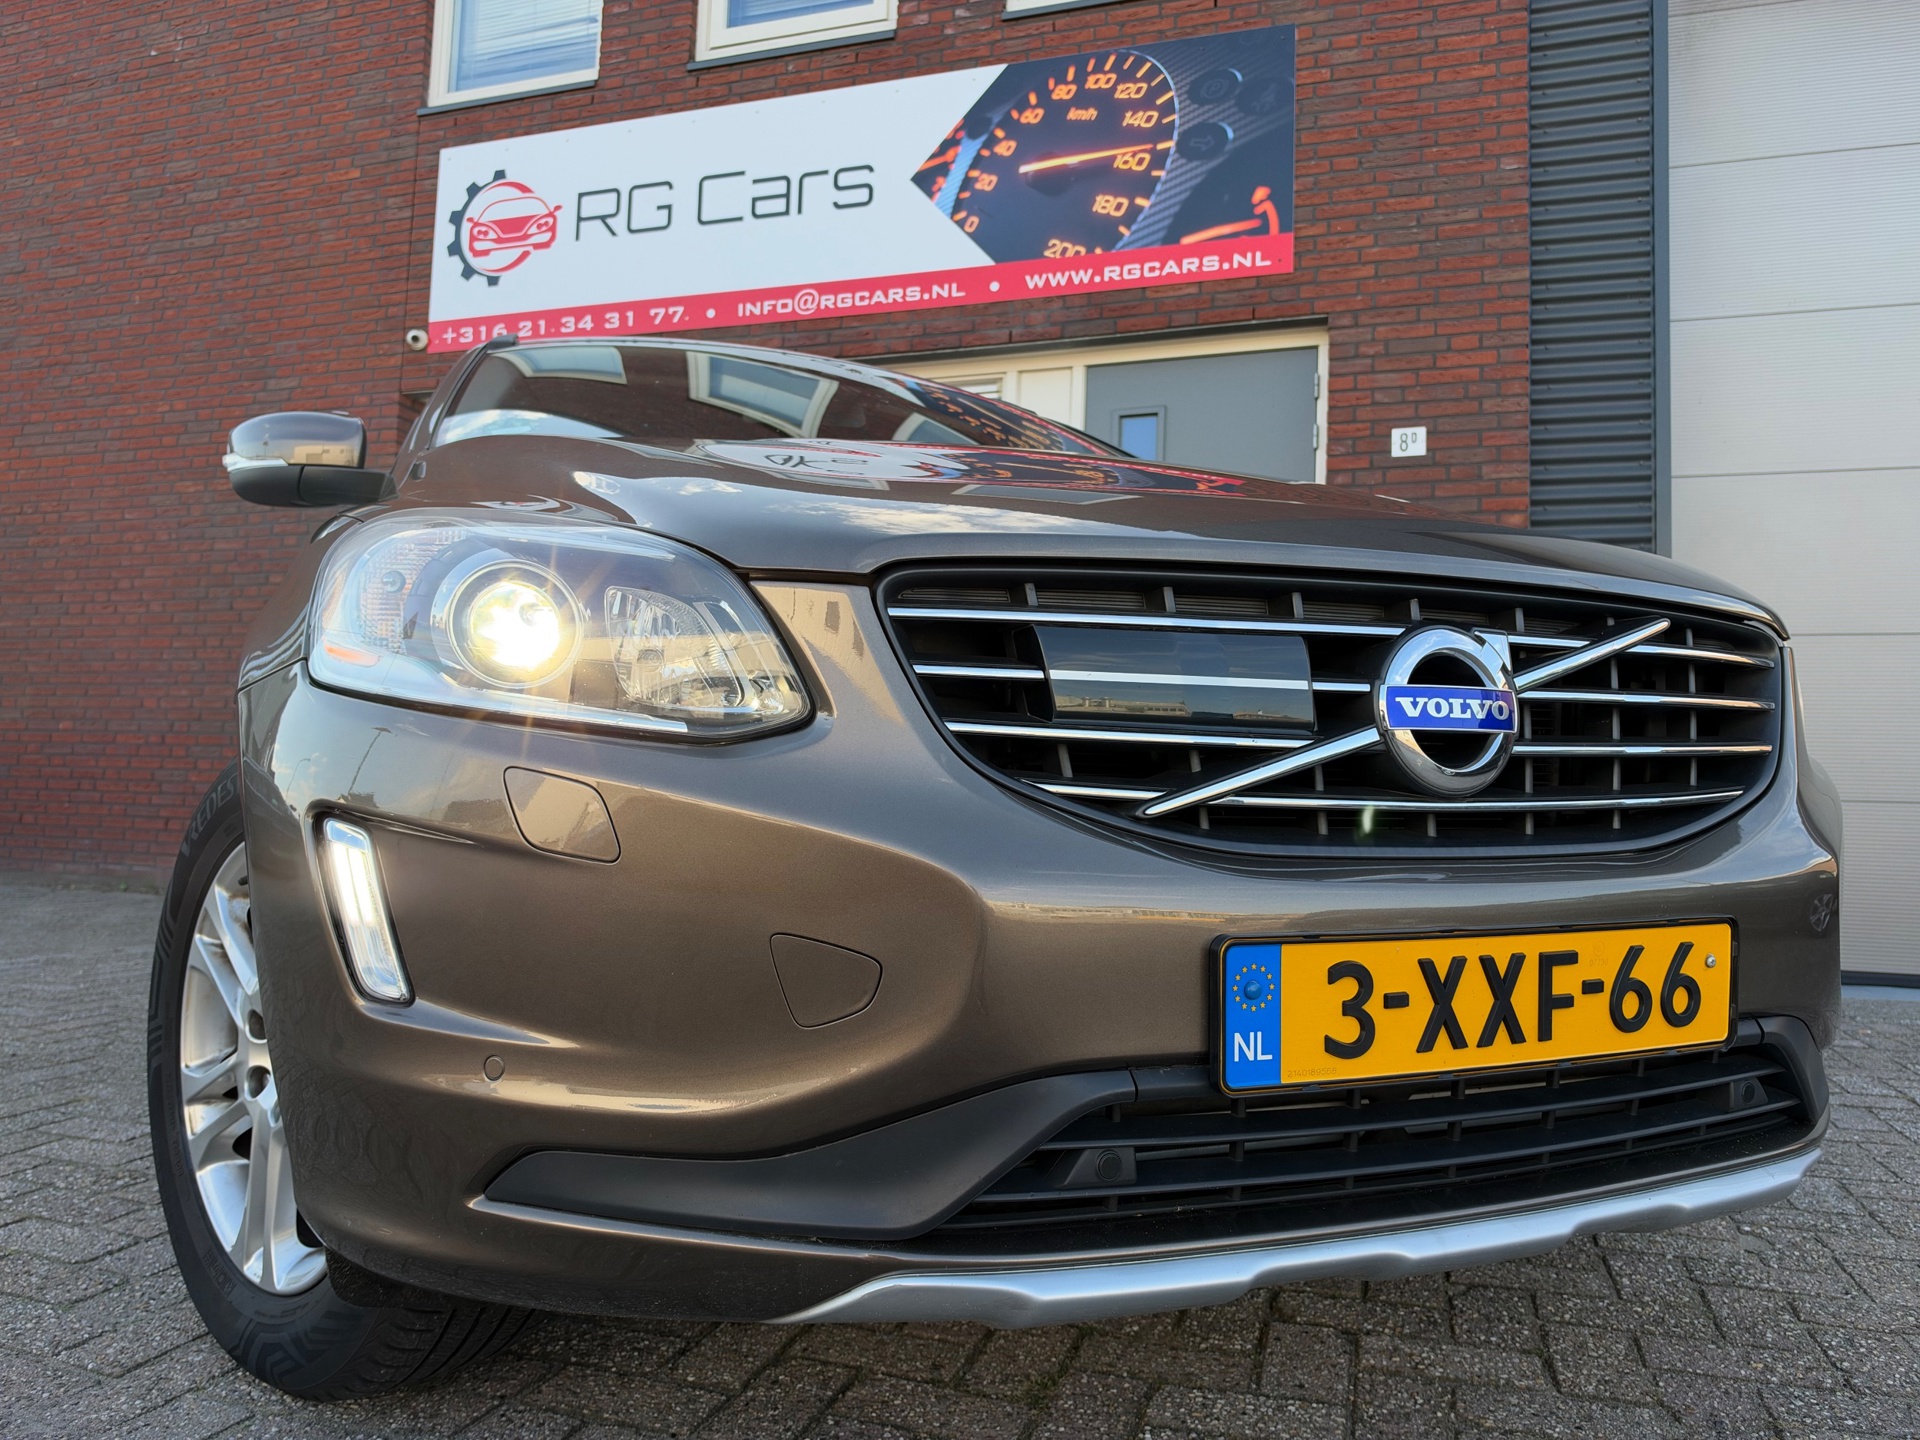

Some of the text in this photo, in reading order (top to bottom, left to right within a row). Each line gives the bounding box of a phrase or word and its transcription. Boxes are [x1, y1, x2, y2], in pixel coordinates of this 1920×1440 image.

[1084, 73, 1117, 89] 100
[1051, 84, 1077, 100] 80
[1114, 82, 1148, 99] 120
[1019, 108, 1045, 124] 60
[1122, 110, 1159, 128] 140
[993, 140, 1017, 156] 40
[1113, 152, 1151, 171] 160
[974, 173, 998, 191] 20
[575, 164, 875, 242] RG Cars
[1092, 194, 1129, 217] 180
[963, 215, 980, 233] 0
[1025, 251, 1272, 290] WWW.RGCARS.NL
[737, 283, 966, 316] INFO@RGCARS.NL
[603, 311, 634, 329] 31
[1395, 697, 1510, 720] VOLVO
[1324, 941, 1702, 1060] 3-XXF-66
[1233, 1032, 1273, 1063] NL
